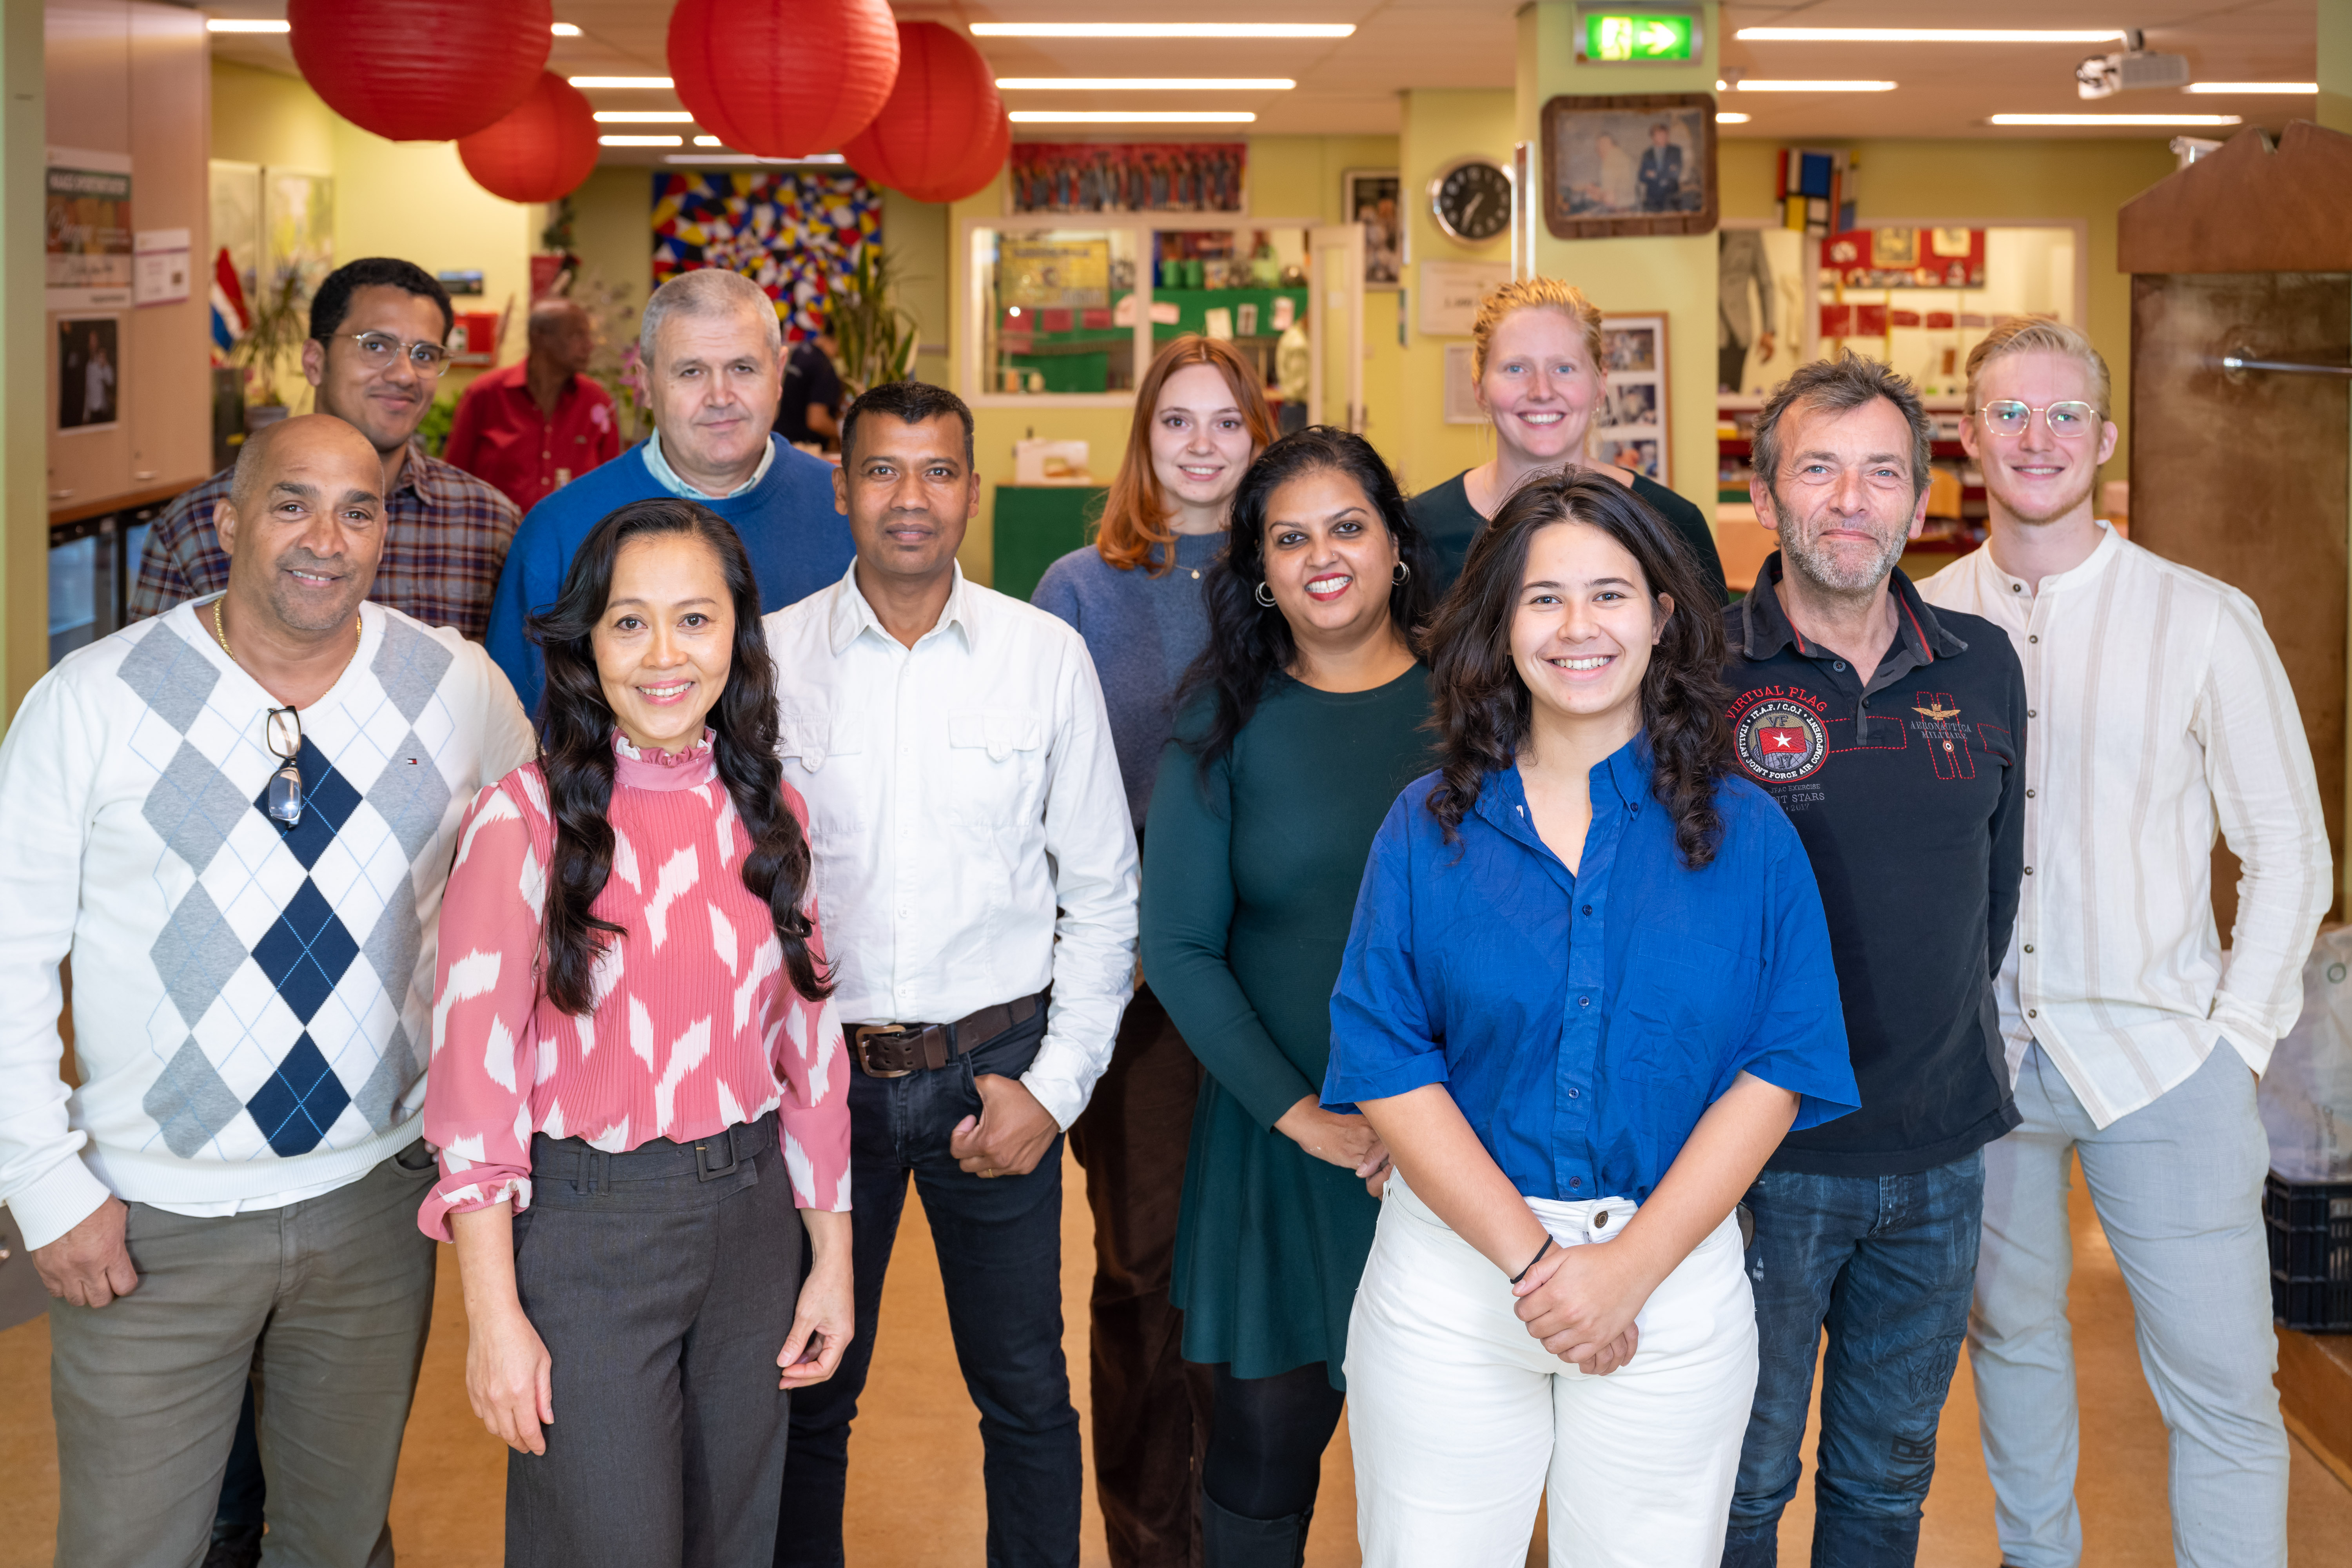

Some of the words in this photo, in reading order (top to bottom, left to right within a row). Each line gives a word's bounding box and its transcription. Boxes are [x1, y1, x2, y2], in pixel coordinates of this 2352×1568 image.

[1725, 686, 1784, 718] VIRTUAL
[1788, 687, 1827, 712] FLAG
[1750, 704, 1775, 719] IT.A.F.
[1782, 704, 1802, 715] C.O.I
[1766, 715, 1789, 727] VF
[1911, 721, 1972, 732] AERONAUTICA
[1921, 731, 1967, 739] MILITARE
[1739, 724, 1749, 757] ITALIAN
[1746, 759, 1768, 776] JOINT
[1769, 771, 1798, 779] FORCE
[1799, 763, 1813, 775] AIR
[1806, 717, 1823, 764] COMPONENT
[1777, 755, 1793, 769] 17
[1792, 793, 1825, 803] STARS
